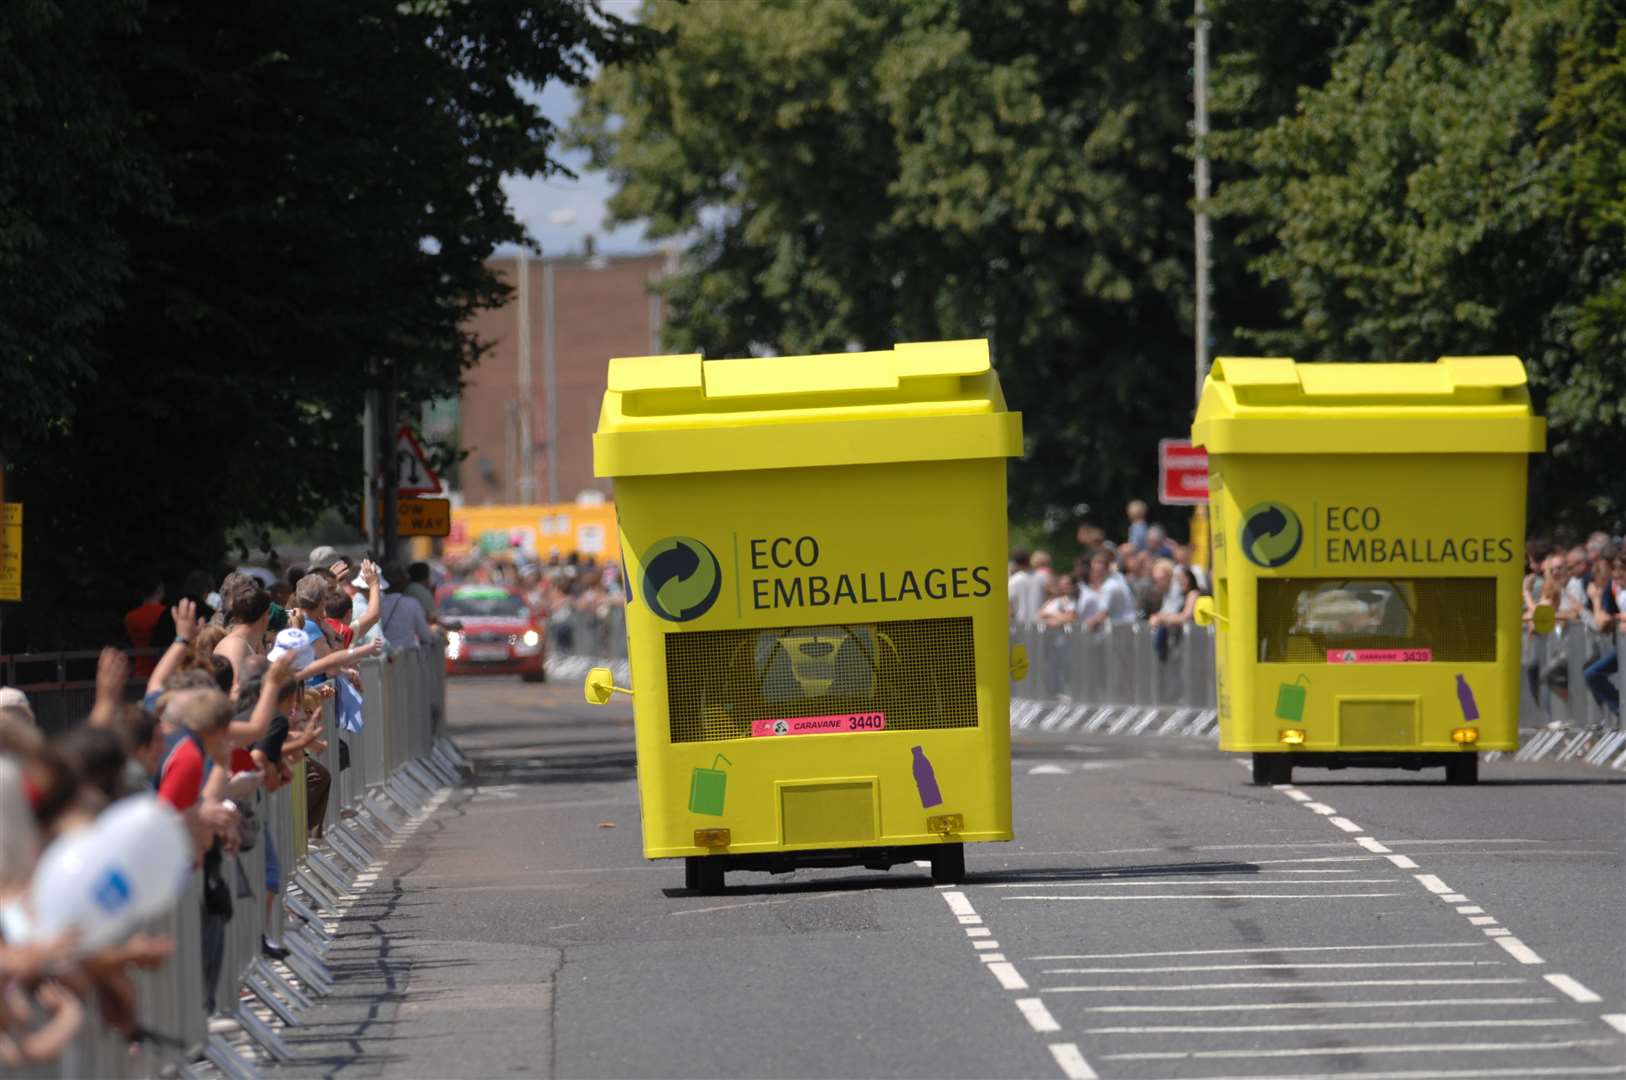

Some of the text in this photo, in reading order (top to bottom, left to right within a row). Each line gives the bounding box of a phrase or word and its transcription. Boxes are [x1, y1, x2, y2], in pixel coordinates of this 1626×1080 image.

[1327, 506, 1380, 533] ECO
[750, 536, 819, 570] ECO
[1327, 538, 1513, 564] EMBALLAGES
[752, 566, 992, 610] EMBALLAGES
[793, 714, 882, 731] CARAVANE 3440
